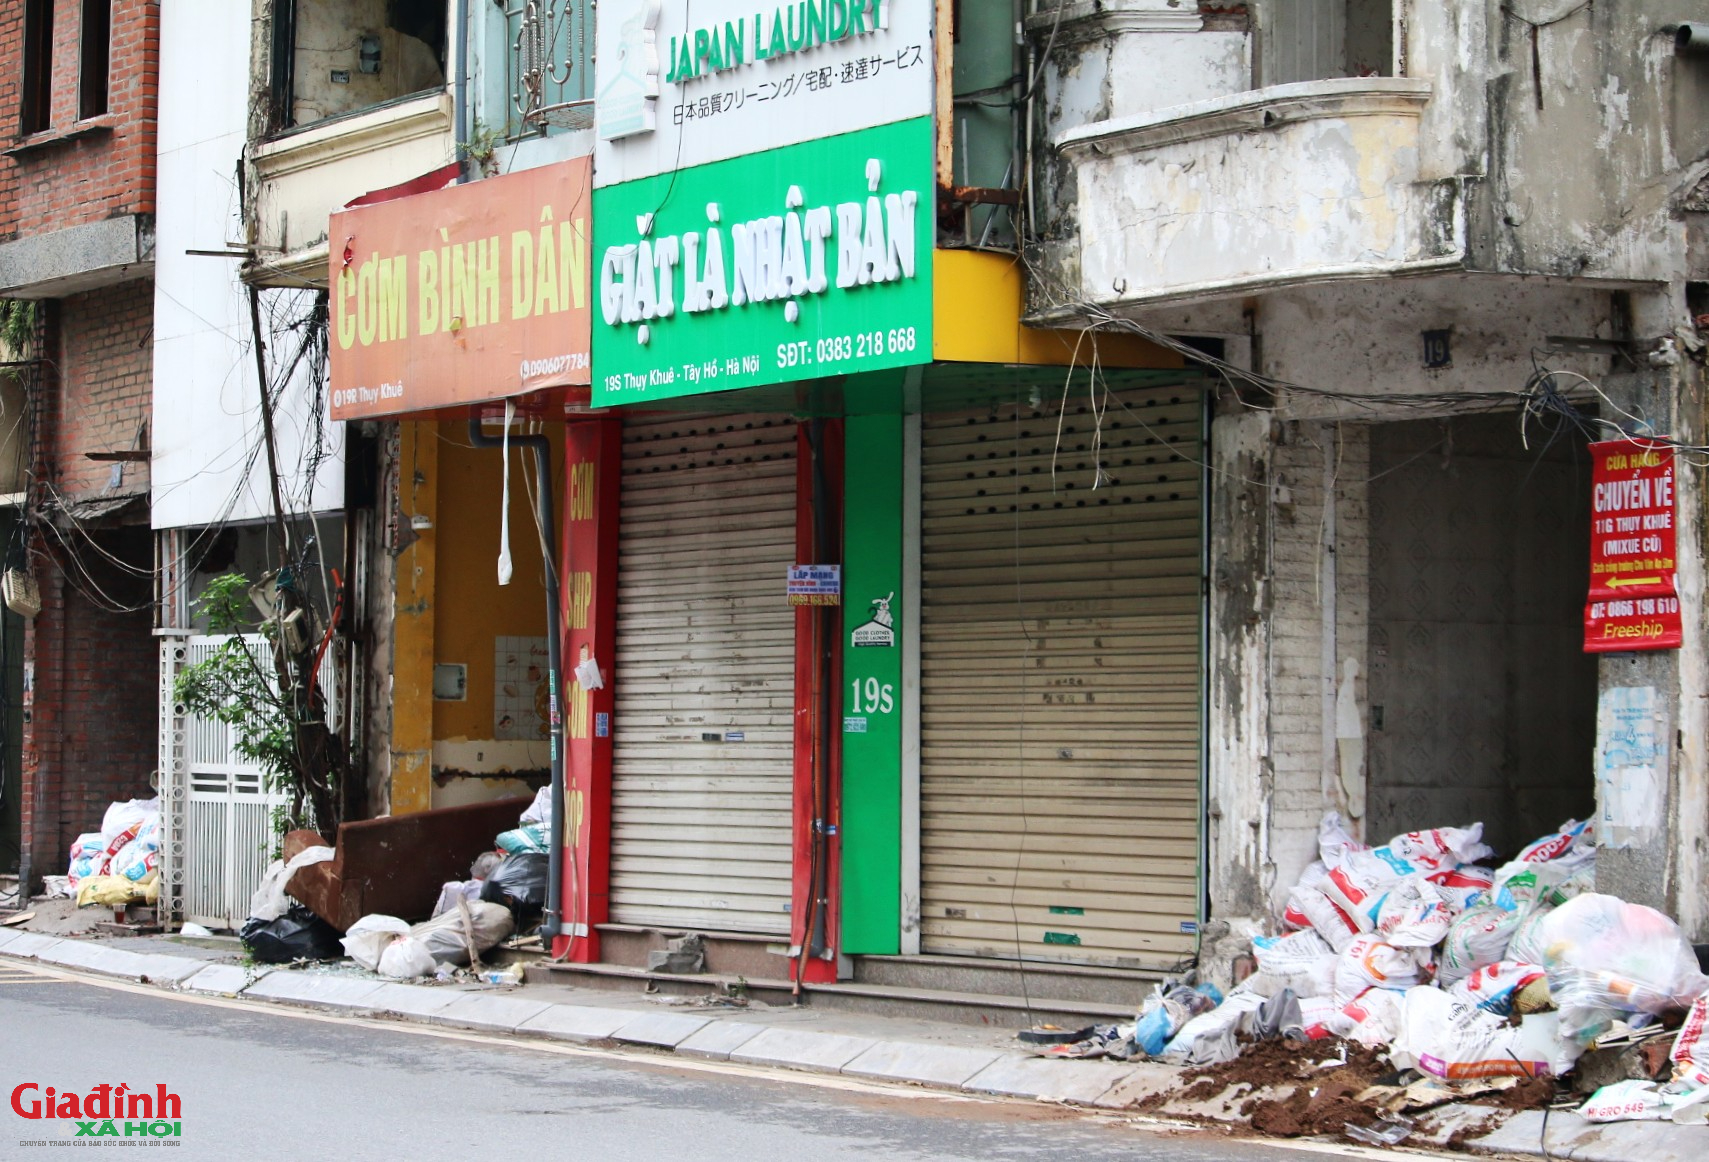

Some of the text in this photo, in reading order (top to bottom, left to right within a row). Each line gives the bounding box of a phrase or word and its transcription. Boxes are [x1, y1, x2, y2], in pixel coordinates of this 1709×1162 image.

[665, 0, 884, 83] JAPAN LAUNDRY
[600, 157, 918, 345] GIẶT LÀ NHẬT BẢN
[336, 204, 585, 351] CƠM BÌNH DÂN
[777, 326, 916, 369] SĐT: 0383 218 668
[1428, 340, 1445, 363] 19
[380, 379, 404, 400] Khuê
[604, 374, 622, 392] 19S
[624, 373, 648, 392] Thụy
[650, 366, 675, 386] Khuê
[683, 363, 701, 384] Tây
[726, 357, 740, 376] Hà
[742, 354, 760, 376] Nội
[571, 457, 594, 521] CƠM
[1594, 466, 1673, 513] CHUYỂN VỀ
[1643, 510, 1672, 530] KHUÊ
[1603, 538, 1641, 557] (MIXUE
[567, 572, 591, 629] SHIP
[1657, 597, 1678, 614] 610
[1603, 619, 1664, 640] Freeship
[1623, 1102, 1645, 1115] 549
